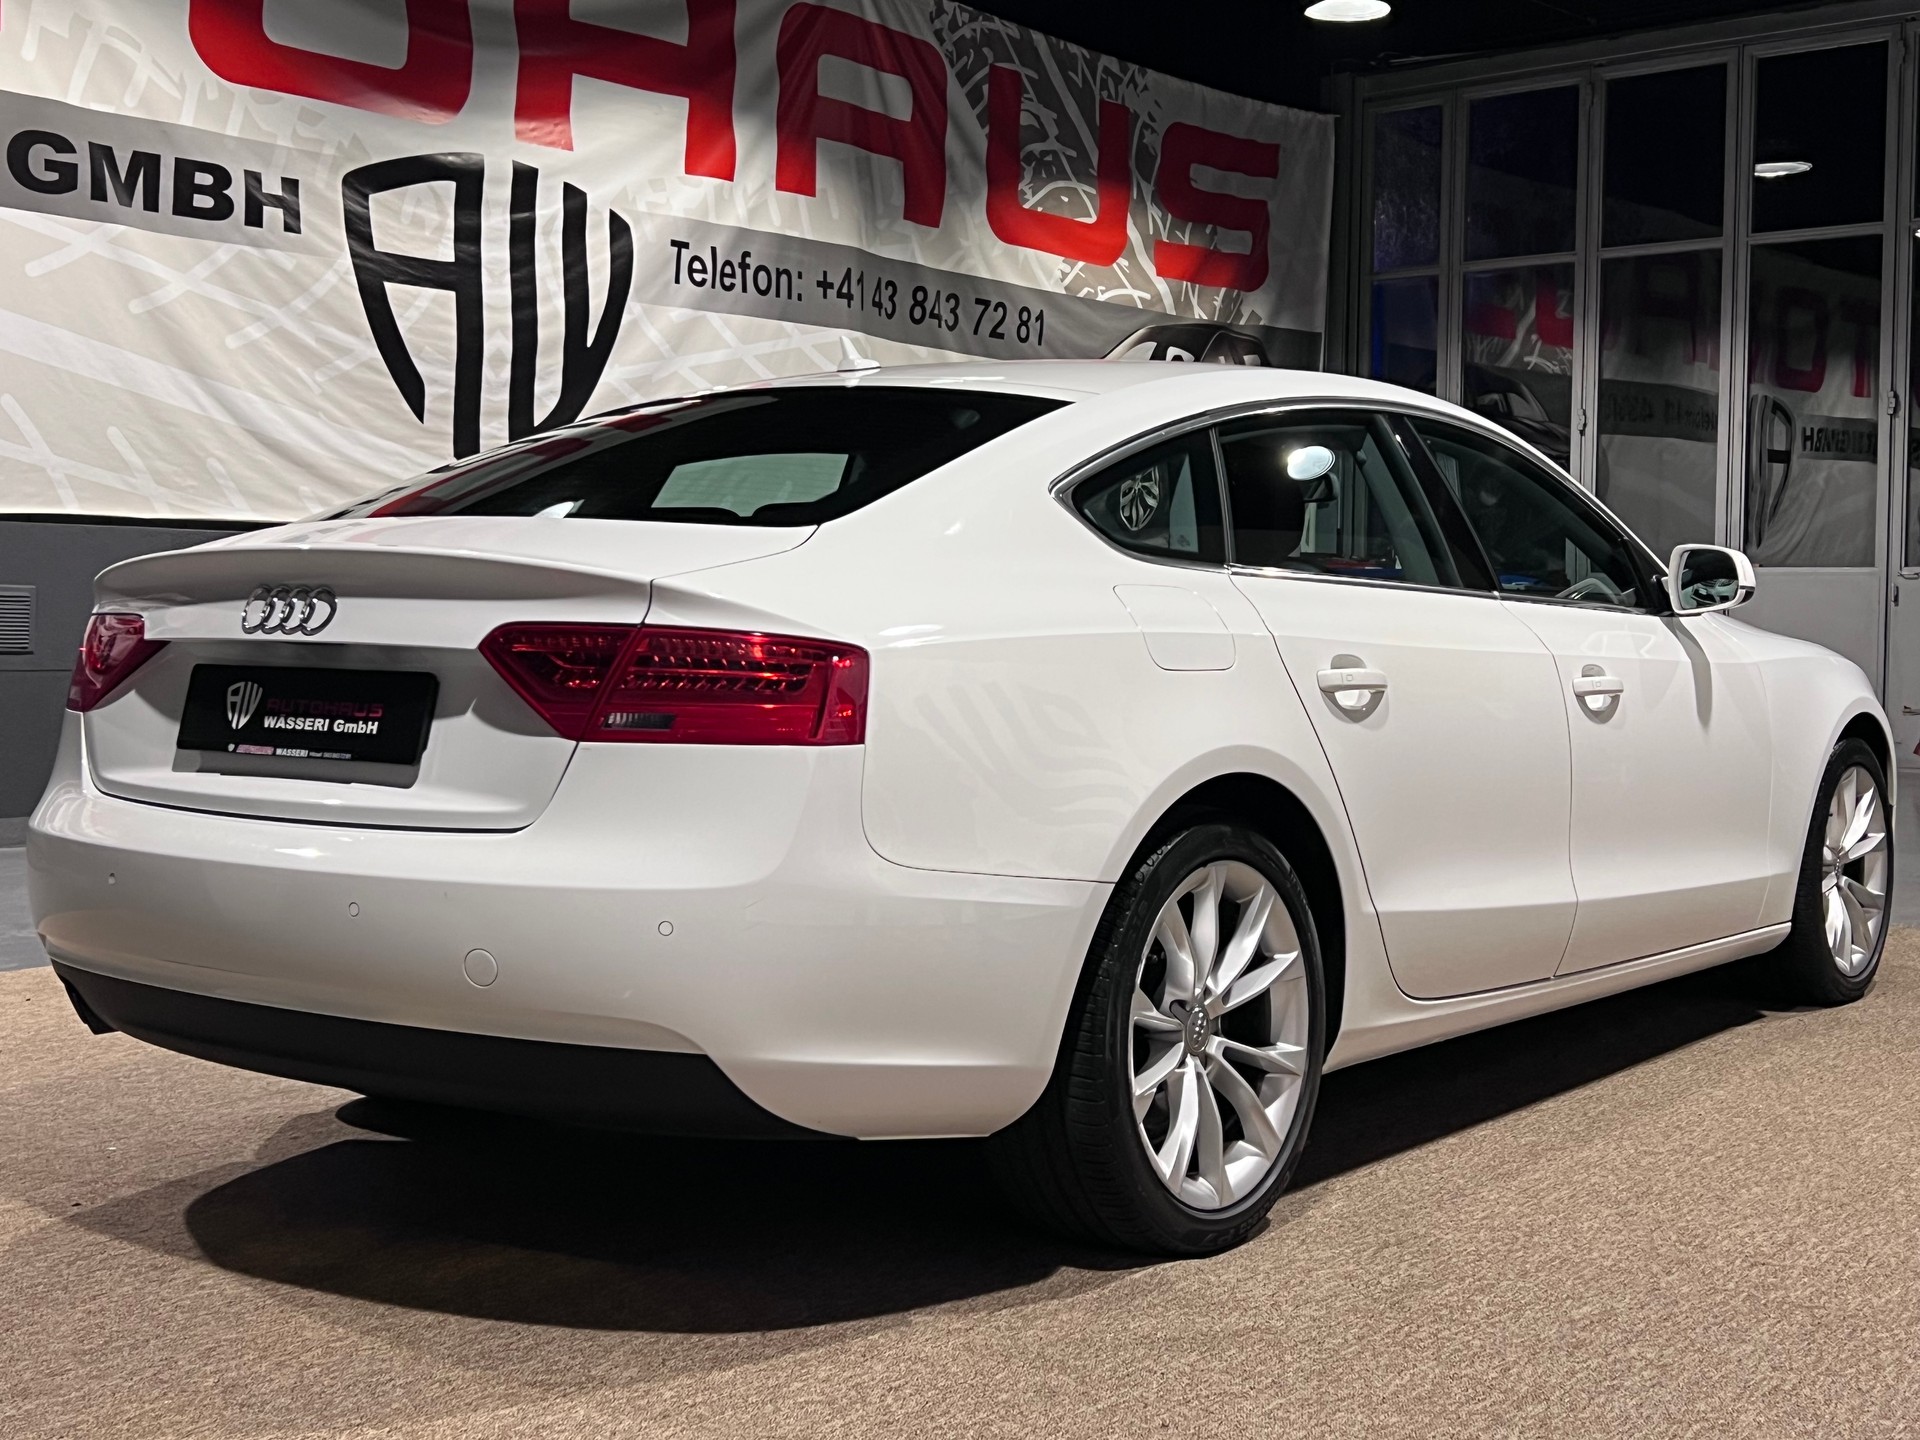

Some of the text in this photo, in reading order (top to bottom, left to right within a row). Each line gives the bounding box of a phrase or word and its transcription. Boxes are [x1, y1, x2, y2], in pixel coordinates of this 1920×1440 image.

[6, 130, 301, 234] GMBH
[670, 239, 802, 302] Telefon:
[909, 285, 961, 332] 843
[972, 297, 1008, 340] 72
[1016, 305, 1044, 347] 81
[267, 699, 384, 718] AUTOHAUS
[333, 719, 379, 735] GmbH
